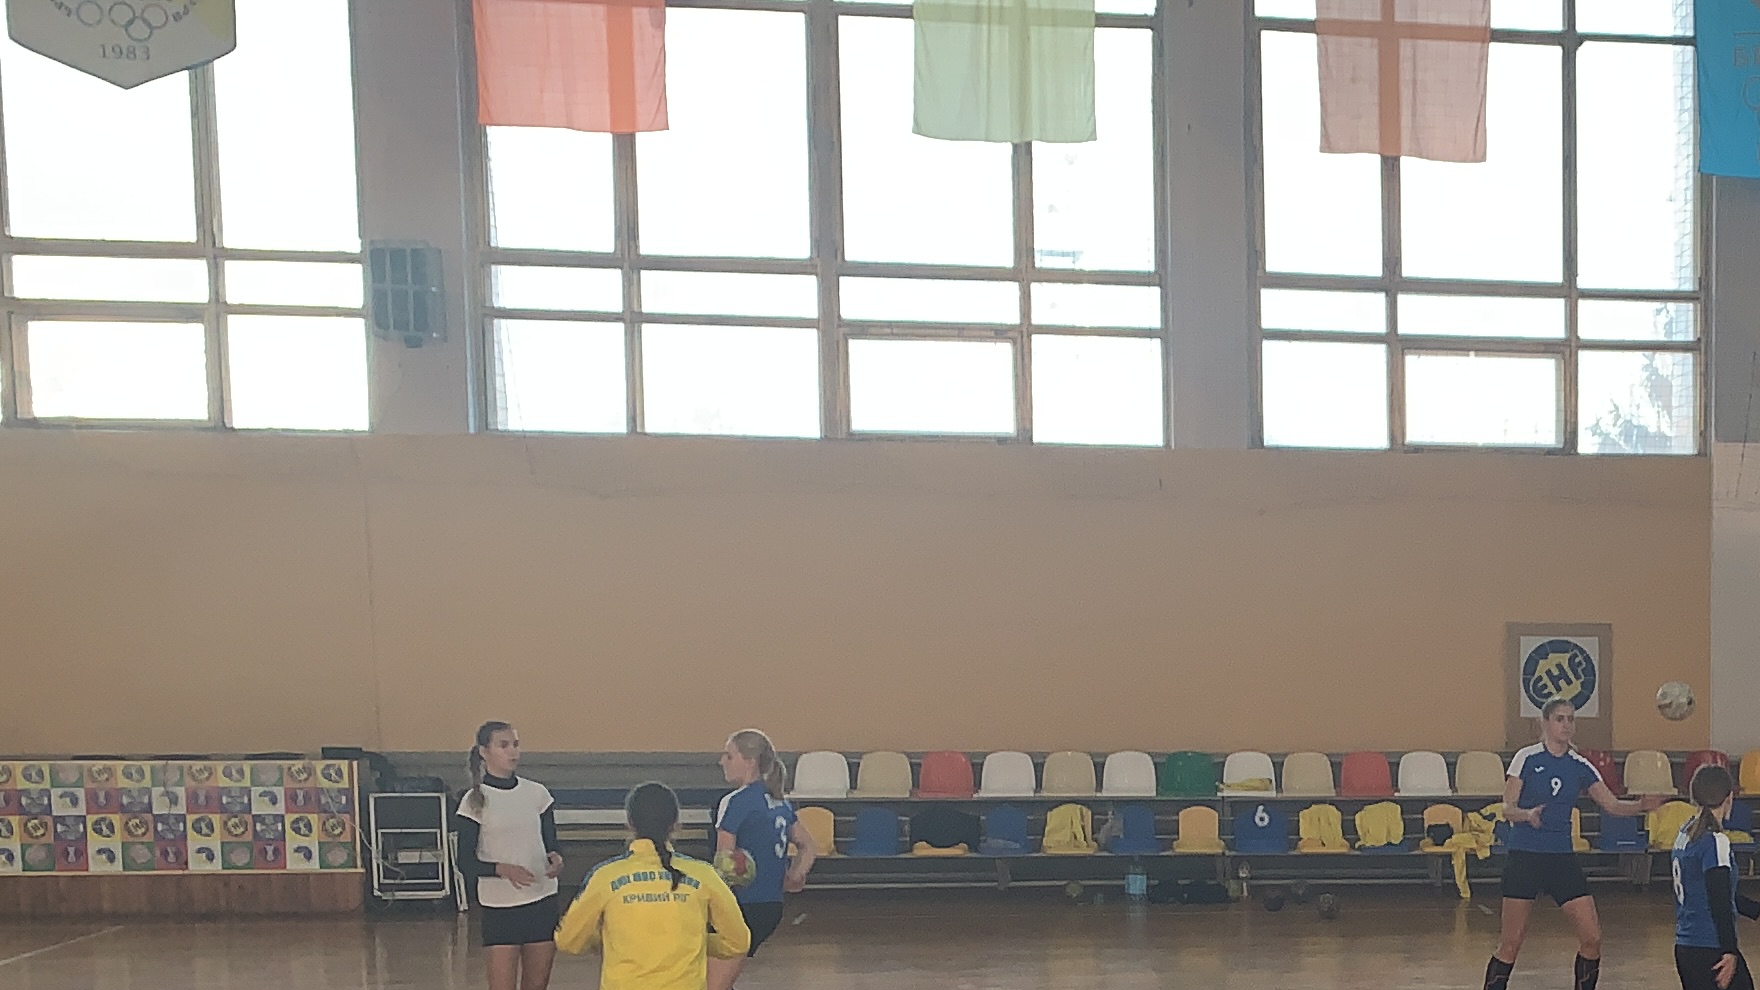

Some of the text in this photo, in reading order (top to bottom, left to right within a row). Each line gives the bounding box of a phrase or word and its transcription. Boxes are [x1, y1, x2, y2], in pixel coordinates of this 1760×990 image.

[100, 44, 150, 61] 1983
[1531, 651, 1585, 700] EHF
[1551, 777, 1562, 796] 9
[1254, 804, 1270, 827] 6
[775, 816, 787, 858] 3
